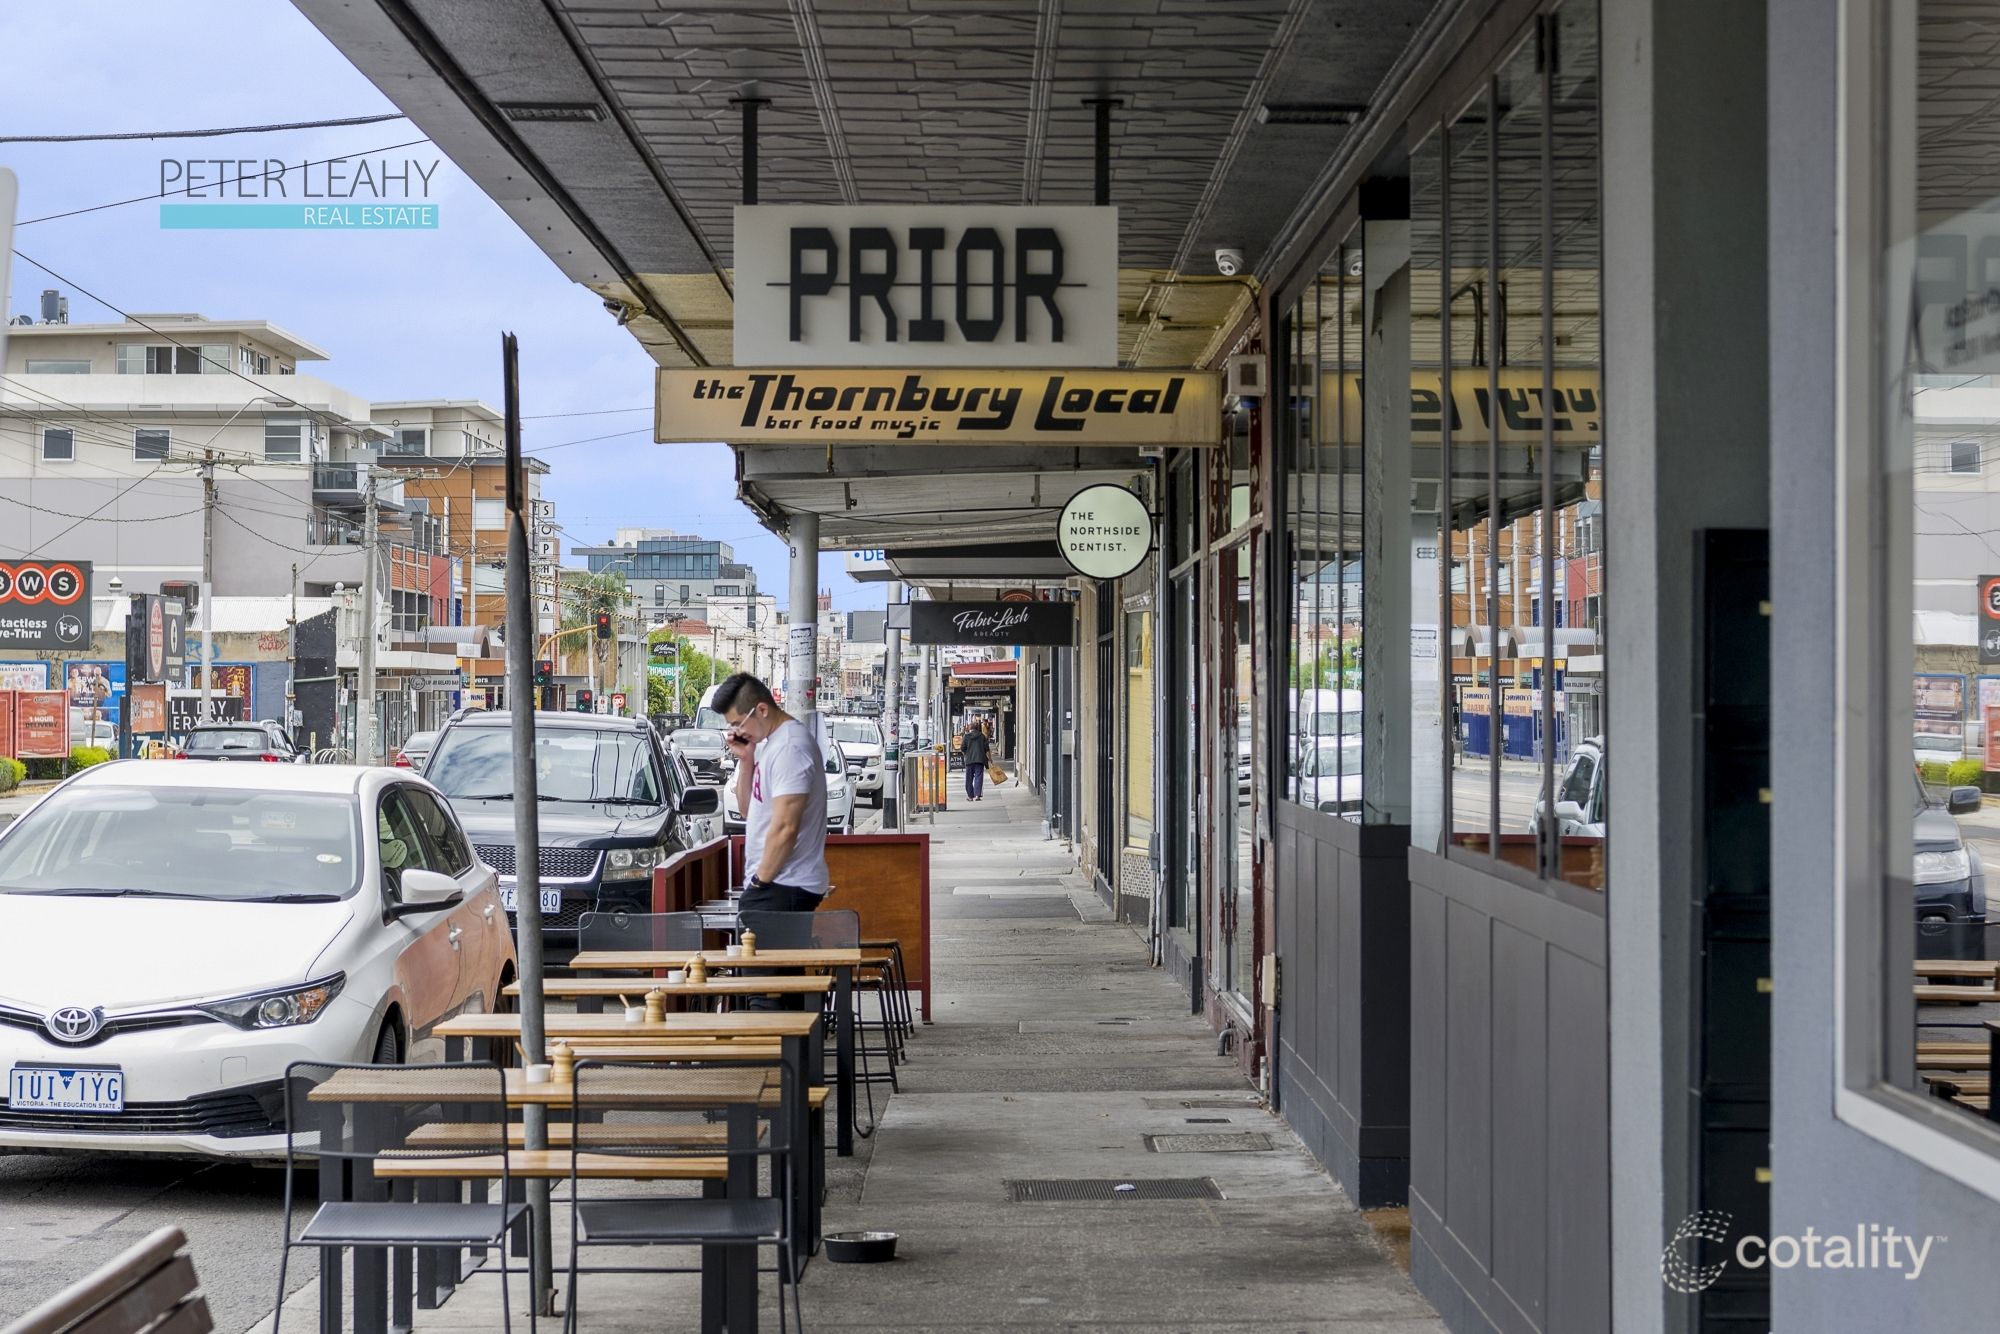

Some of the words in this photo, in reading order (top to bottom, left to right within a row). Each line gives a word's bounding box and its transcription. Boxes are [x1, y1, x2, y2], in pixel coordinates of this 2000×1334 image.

[790, 227, 1064, 342] PRIOR
[693, 379, 745, 399] the
[740, 375, 1023, 430] Thornbury
[1034, 376, 1186, 431] Local
[764, 415, 803, 430] bar
[810, 415, 863, 430] food
[870, 415, 941, 438] music
[1070, 512, 1094, 520] THE
[1070, 527, 1140, 535] NORTHSIDE
[1070, 543, 1127, 551] DENTIST.
[0, 618, 48, 628] tactless
[18, 1075, 54, 1100] 1UI
[79, 1077, 118, 1102] 1YG
